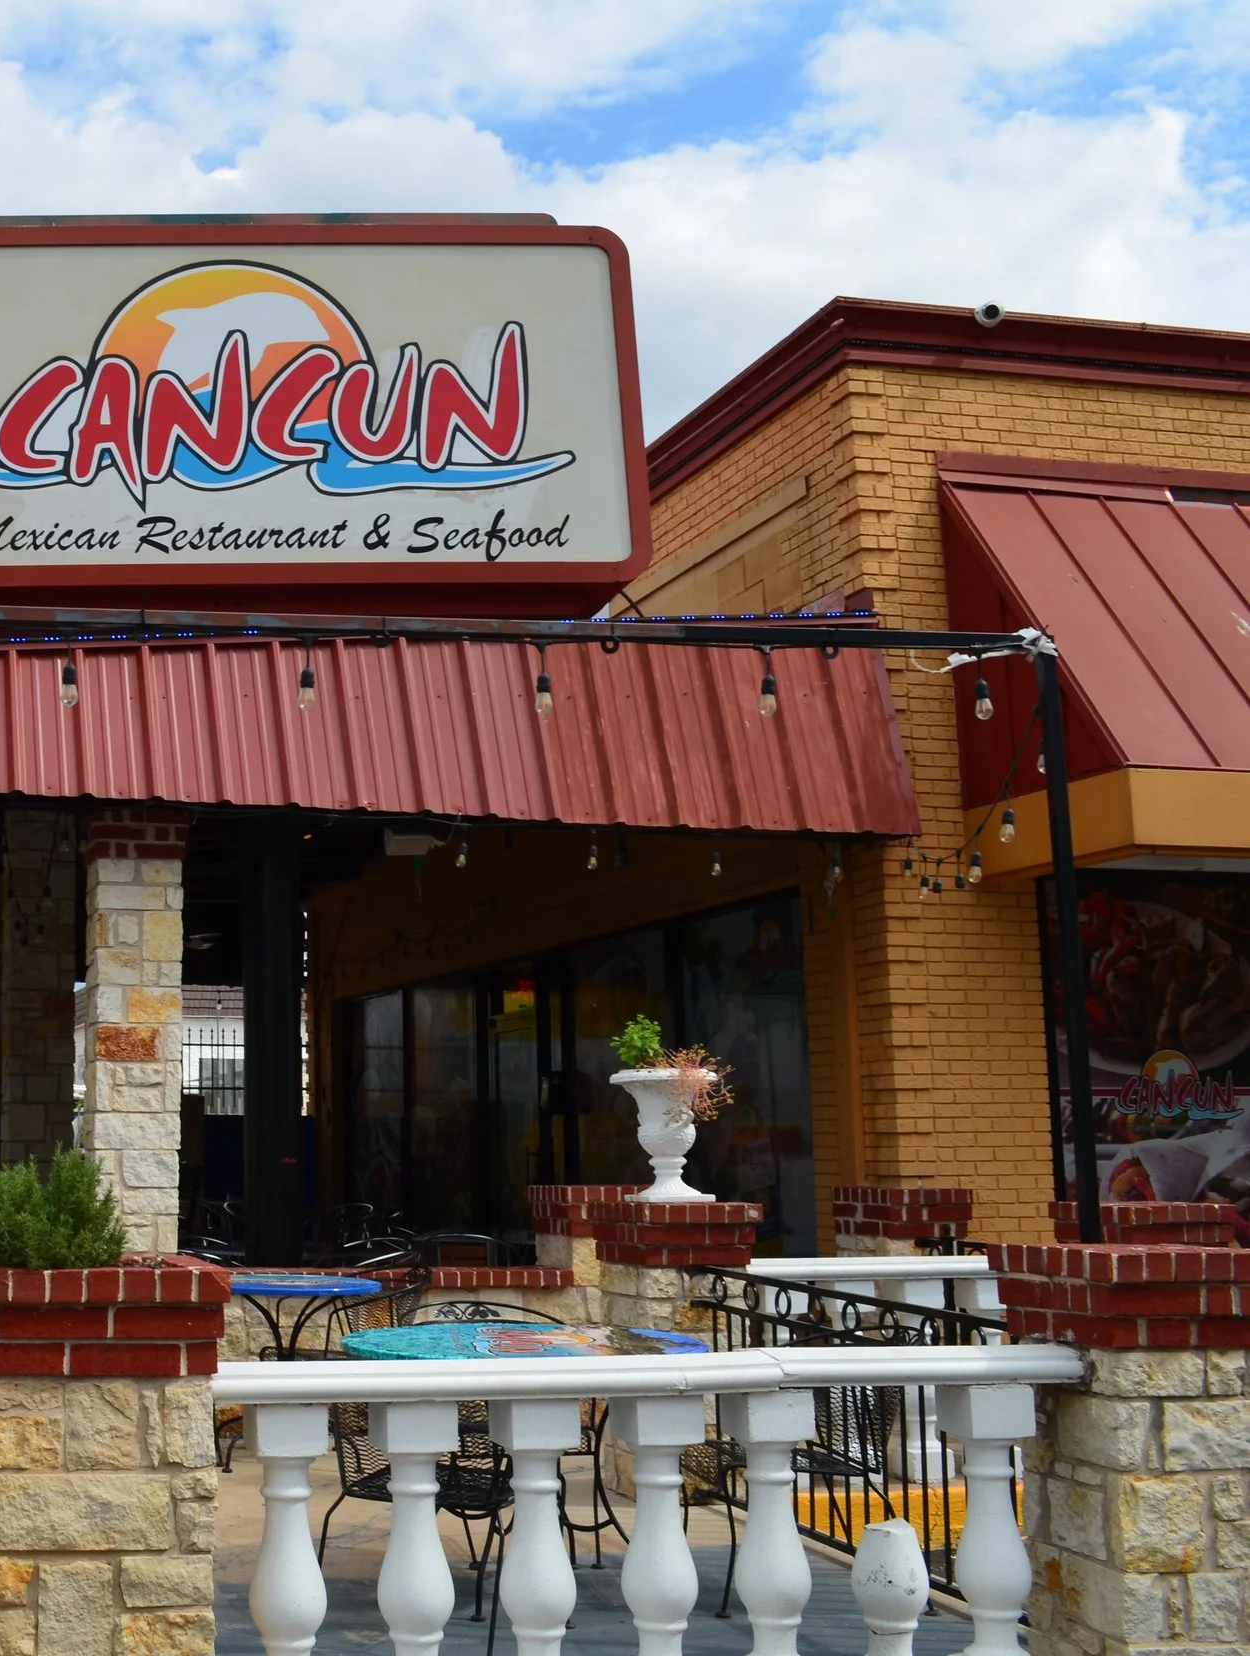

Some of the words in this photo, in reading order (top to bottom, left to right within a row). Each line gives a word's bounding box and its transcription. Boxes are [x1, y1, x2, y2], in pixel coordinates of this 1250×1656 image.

[135, 515, 348, 555] Restaurant
[363, 513, 391, 552] &
[406, 514, 571, 562] Seafood
[1120, 1069, 1234, 1116] CANCUN
